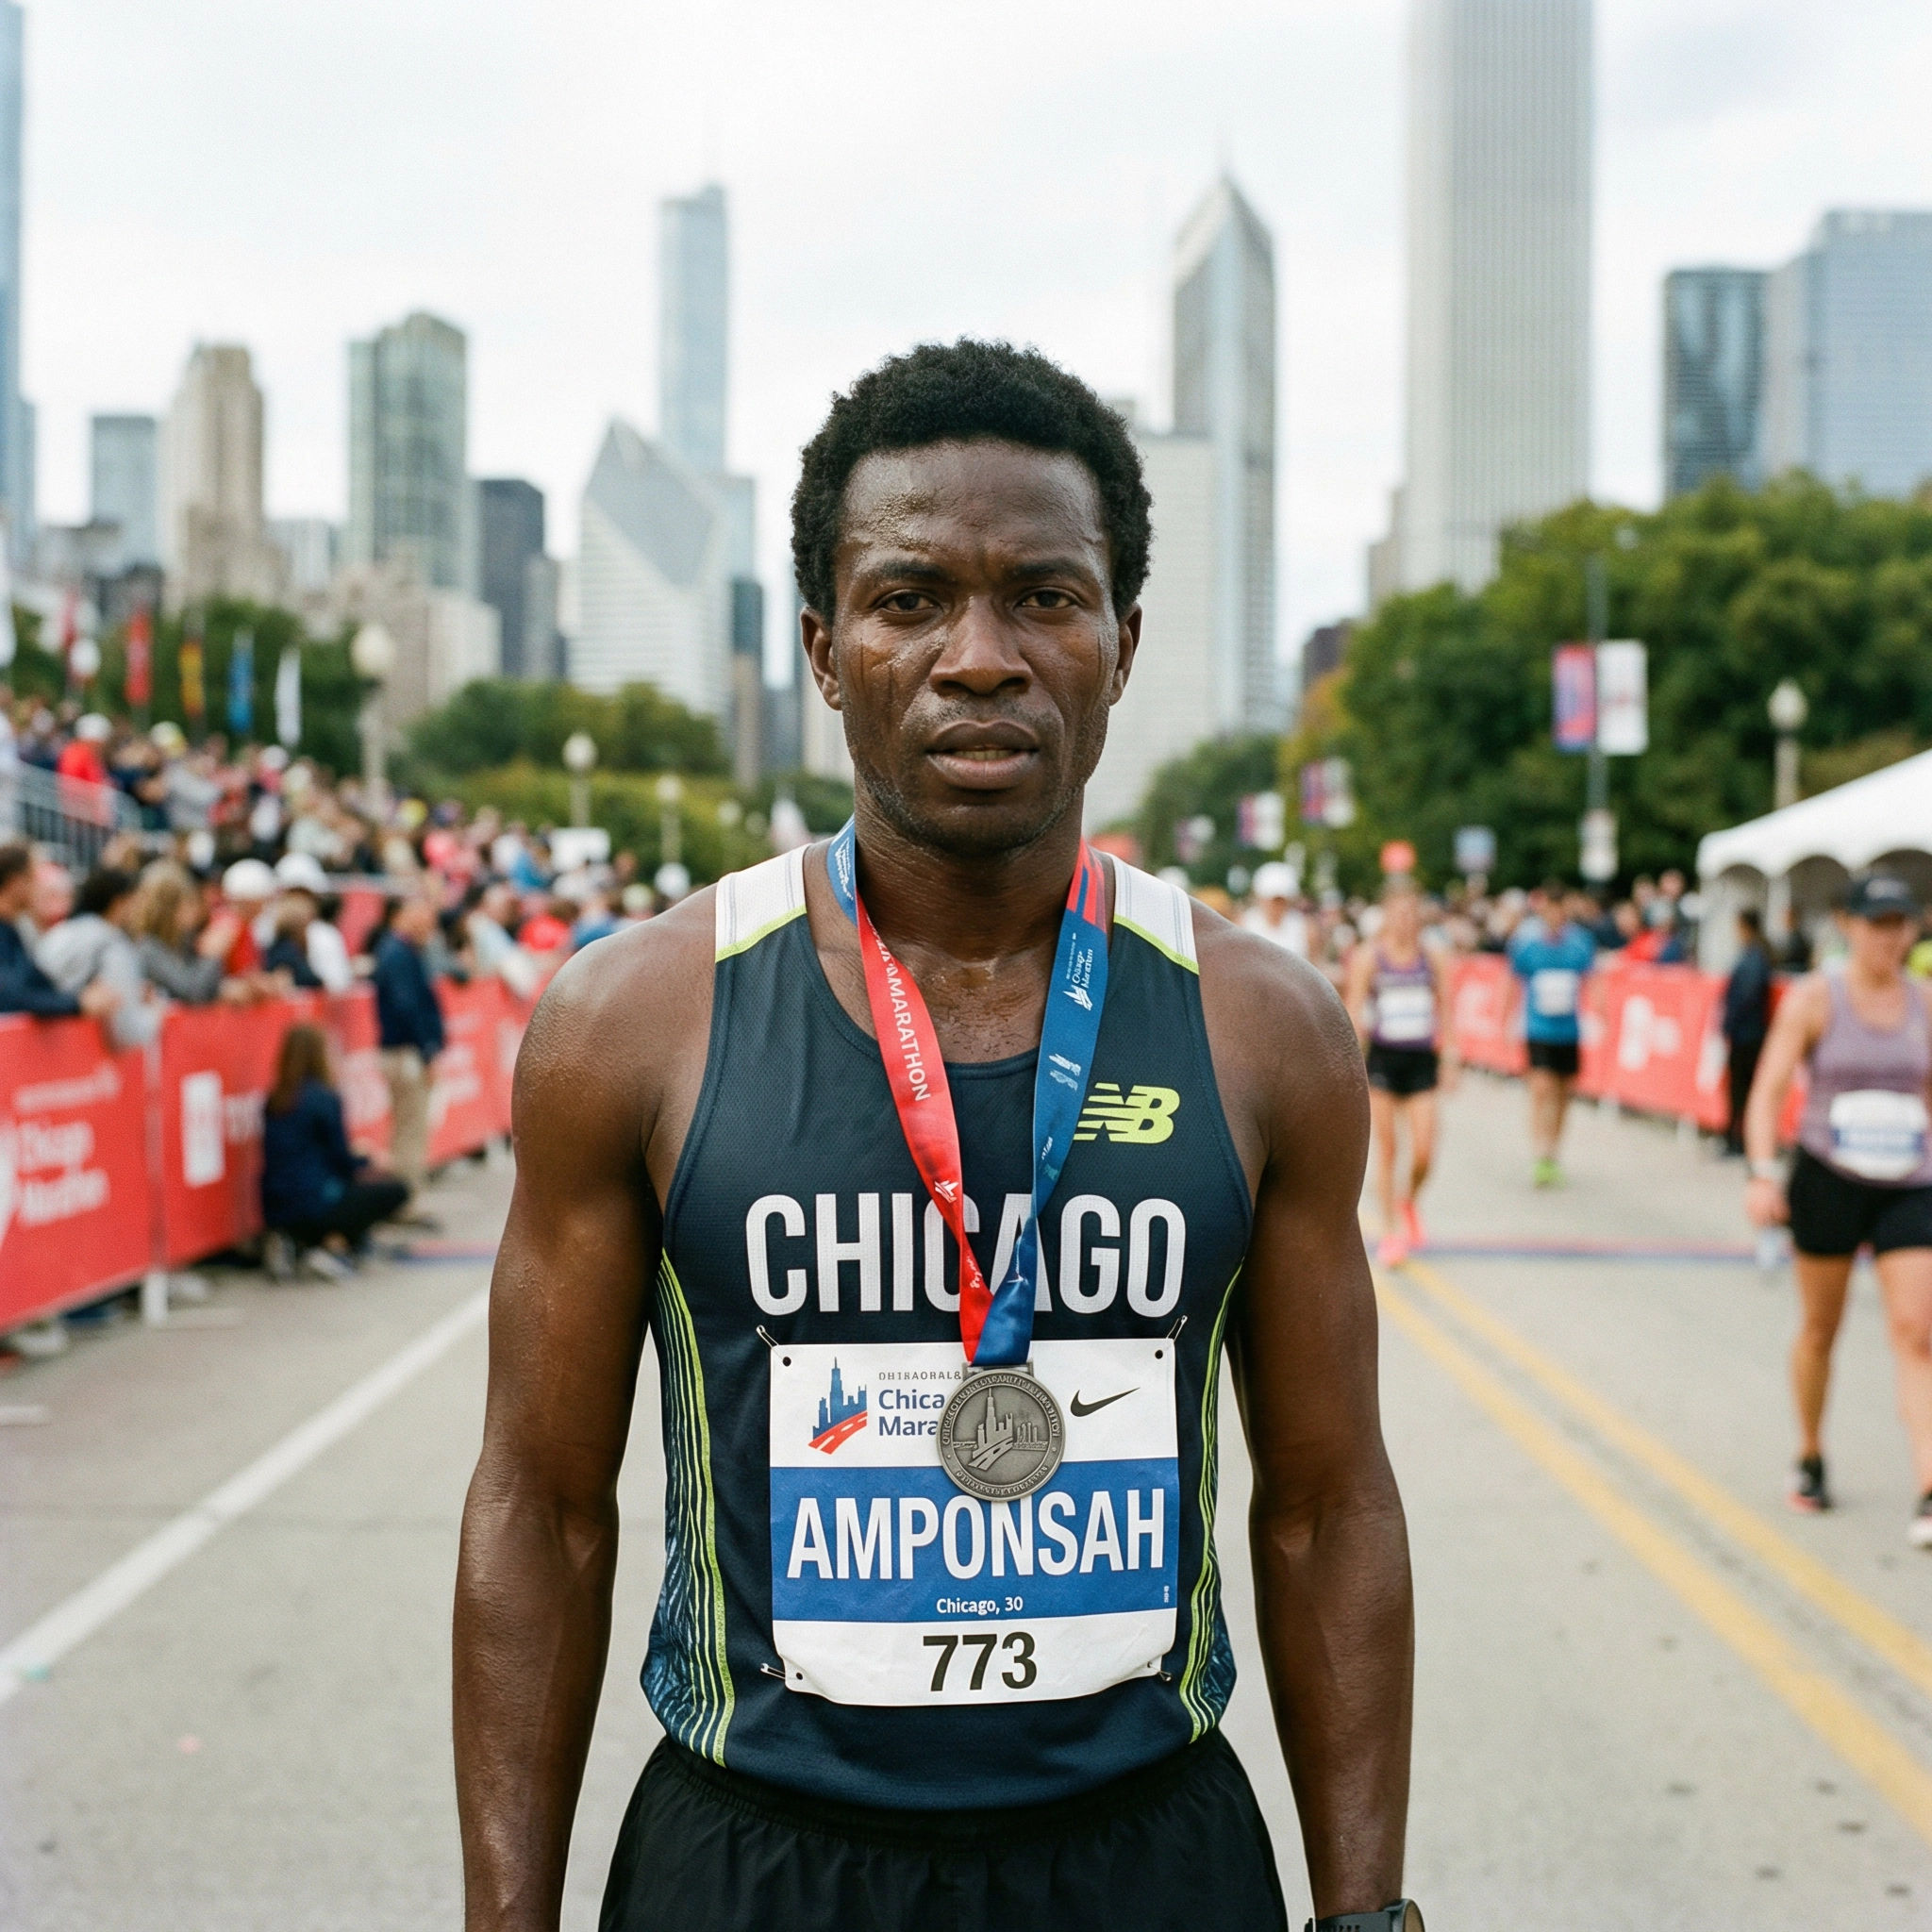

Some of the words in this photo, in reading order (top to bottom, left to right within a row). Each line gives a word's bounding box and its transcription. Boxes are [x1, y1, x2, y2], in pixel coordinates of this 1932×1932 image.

[1073, 1082, 1180, 1143] NB
[745, 1192, 1186, 1317] CHICAGO
[787, 1489, 1164, 1579] AMPONSAH
[936, 1597, 1000, 1615] Chicago,
[1005, 1596, 1024, 1611] 30
[923, 1631, 1038, 1691] 773
